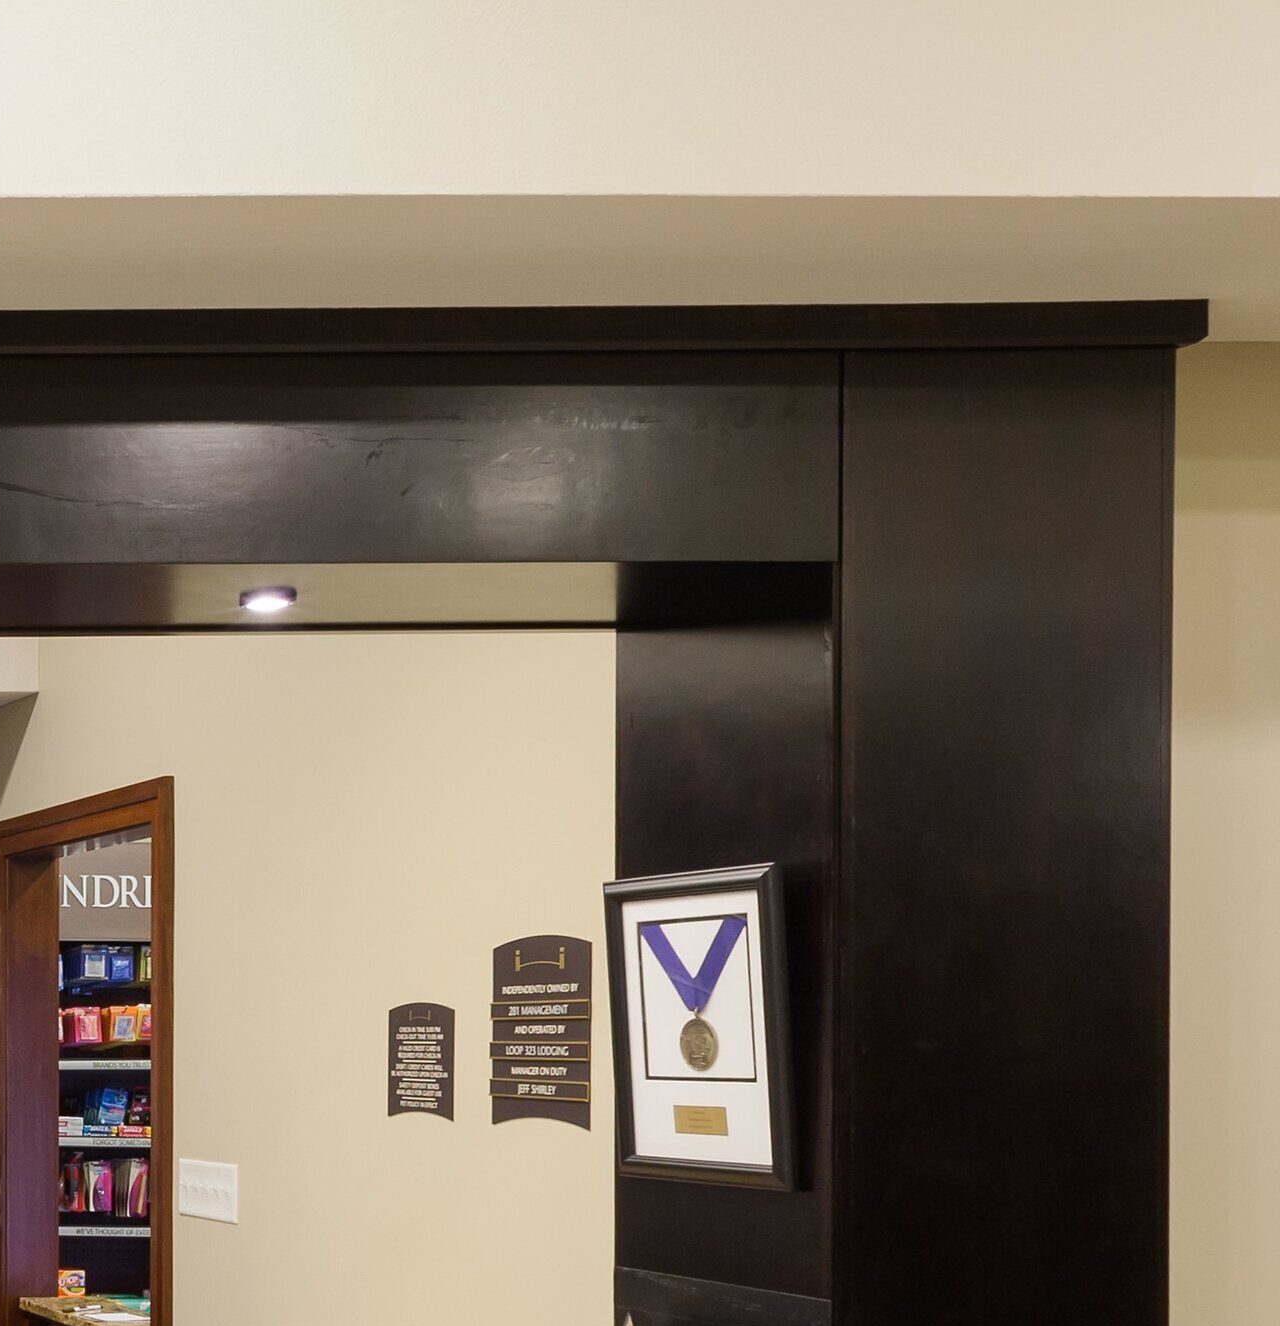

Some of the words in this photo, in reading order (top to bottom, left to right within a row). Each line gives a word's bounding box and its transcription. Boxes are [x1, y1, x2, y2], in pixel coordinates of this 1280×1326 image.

[502, 985, 546, 995] INDEPENDENTLY
[546, 983, 570, 993] OWNED
[570, 983, 579, 992] BY
[508, 1006, 520, 1016] 281
[521, 1004, 569, 1015] MANAGEMENT
[514, 1025, 528, 1034] AND
[528, 1025, 557, 1035] OPERATED
[557, 1025, 566, 1034] BY
[505, 1045, 524, 1055] LOOP
[524, 1045, 536, 1055] 323
[537, 1046, 569, 1056] LODGING
[511, 1066, 539, 1075] MANAGER
[540, 1067, 549, 1075] ON
[550, 1067, 568, 1076] DUTY
[517, 1084, 530, 1095] JEFF
[531, 1084, 557, 1095] SHIRLEY
